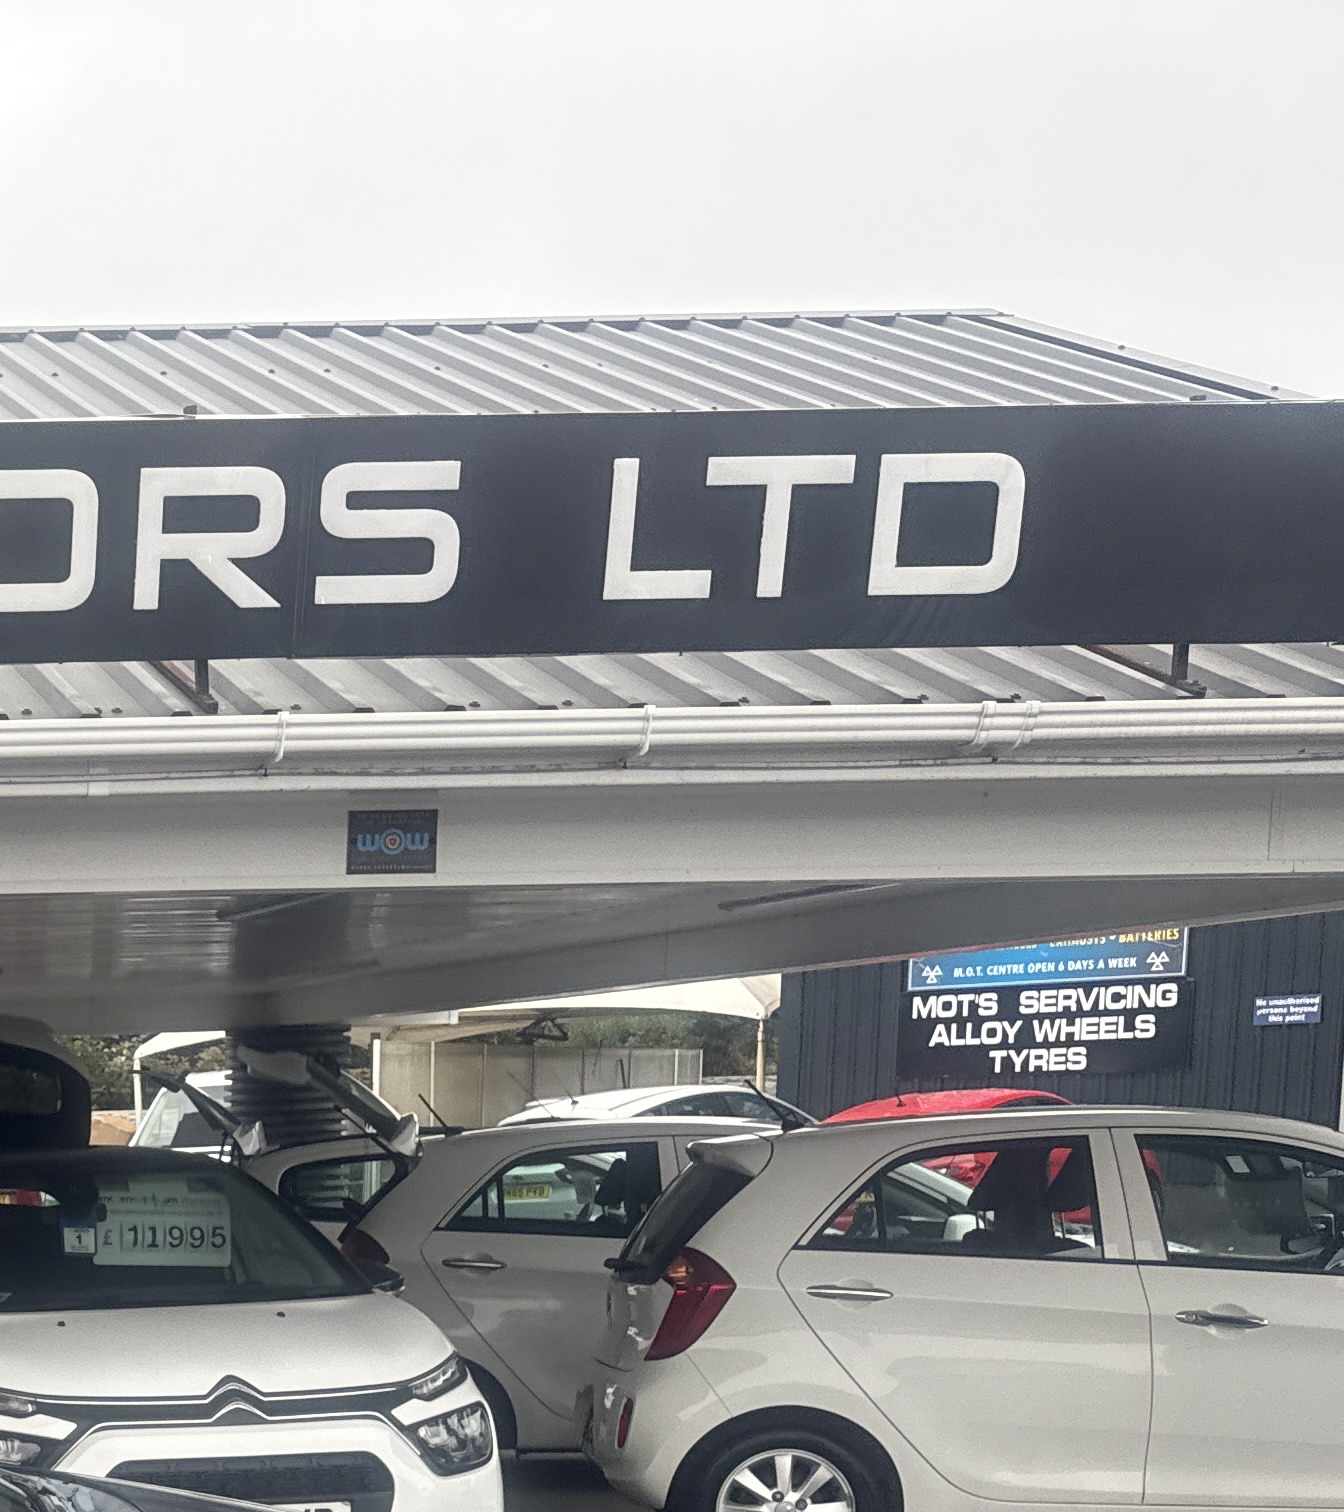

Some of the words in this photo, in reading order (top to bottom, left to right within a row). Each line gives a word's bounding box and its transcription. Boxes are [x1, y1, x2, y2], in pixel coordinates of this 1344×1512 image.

[602, 452, 1026, 601] LTD
[986, 963, 1025, 976] CENTRE
[1027, 961, 1055, 973] OPEN
[1057, 960, 1065, 971] 6
[1067, 958, 1095, 971] DAYS
[1096, 958, 1105, 970] A
[1108, 956, 1137, 968] WEEK
[912, 992, 999, 1019] MOT'S
[1019, 983, 1179, 1015] SERVICING
[928, 1019, 1023, 1047] ALLOY
[1032, 1014, 1156, 1043] WHEELS
[988, 1046, 1088, 1073] TYRES
